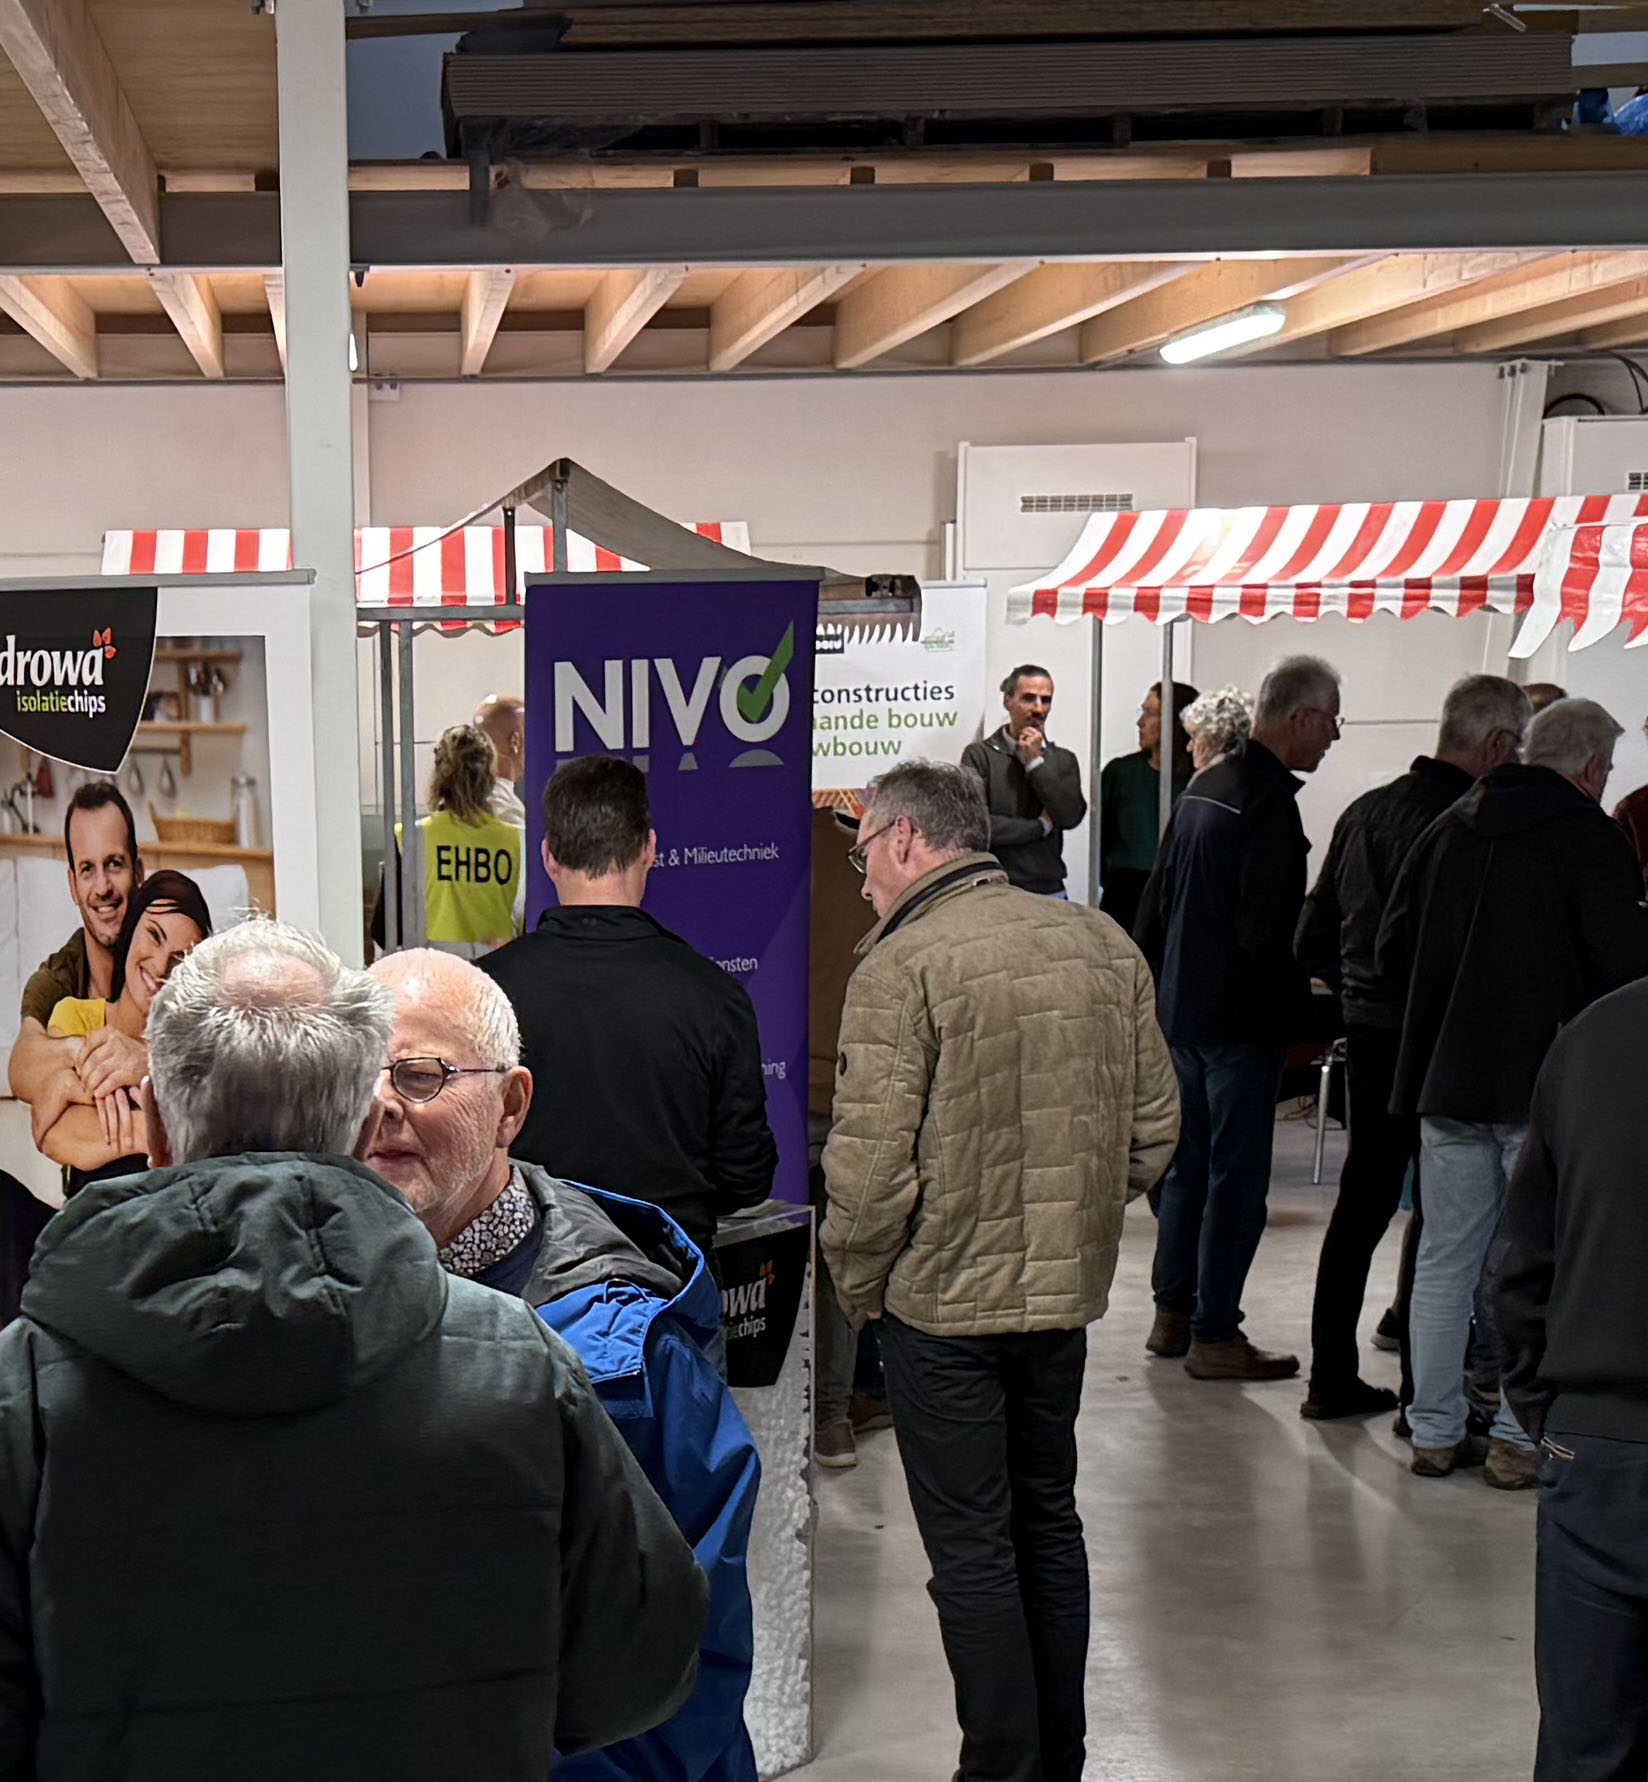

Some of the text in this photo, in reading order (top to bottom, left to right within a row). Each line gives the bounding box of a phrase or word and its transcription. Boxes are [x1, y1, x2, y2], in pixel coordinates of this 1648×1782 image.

[16, 689, 106, 719] isolatiechips
[553, 654, 791, 752] NIVO
[888, 707, 958, 729] bouw
[436, 844, 513, 885] EHBO
[668, 848, 680, 867] &
[684, 842, 779, 865] Milieutechniek
